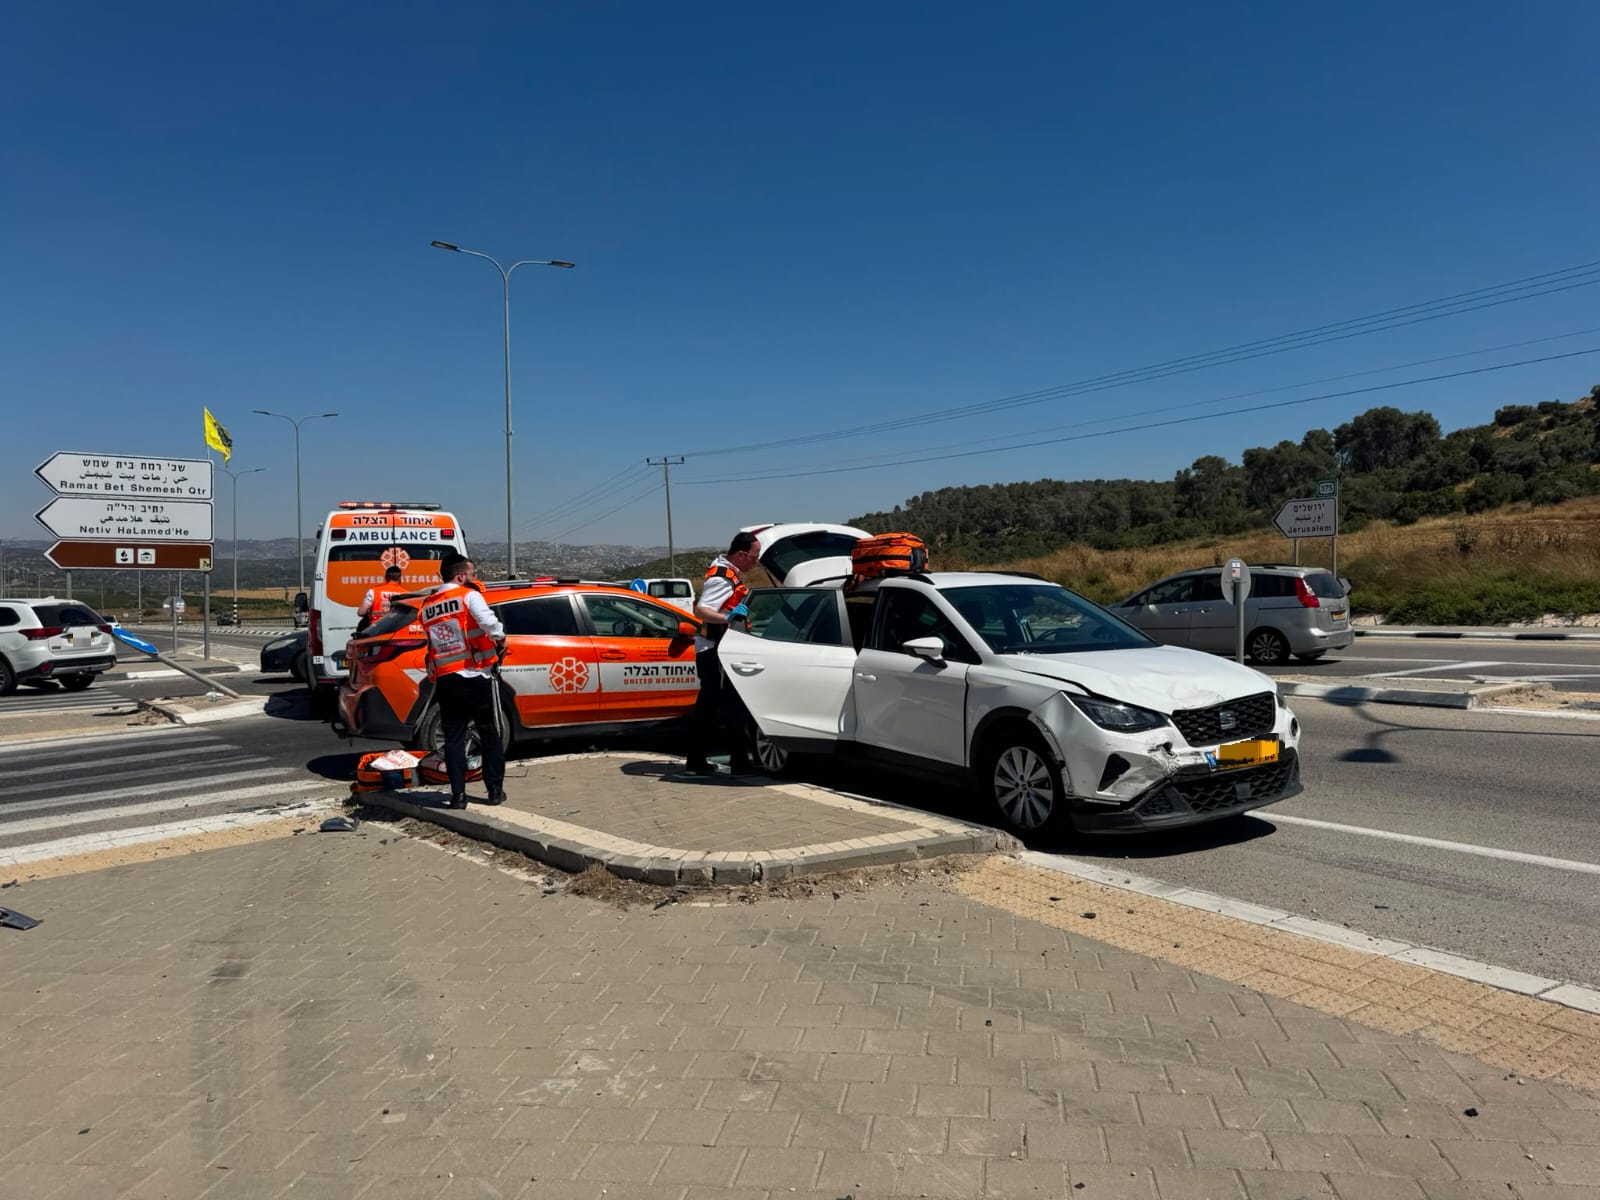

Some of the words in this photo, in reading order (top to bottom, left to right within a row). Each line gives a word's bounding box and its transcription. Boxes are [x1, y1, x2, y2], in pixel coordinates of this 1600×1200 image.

[83, 458, 109, 467] שמש
[116, 460, 134, 470] בית
[140, 461, 162, 471] רמת
[60, 480, 99, 490] Ramat
[104, 483, 124, 491] Bet
[130, 483, 183, 494] Shemesh
[188, 486, 206, 495] Qtr
[141, 504, 164, 513] נתיב
[1293, 503, 1325, 512] ירושלים
[353, 516, 387, 525] הצלה
[399, 516, 433, 526] איחוד
[79, 525, 111, 534] Netiv
[117, 526, 190, 536] HaLamed'He
[1288, 525, 1331, 533] Jerusalem
[349, 531, 437, 540] AMBULANCE
[342, 576, 383, 584] UNITED
[425, 599, 459, 619] חובש
[624, 665, 659, 676] הצלה
[662, 665, 695, 676] איחוד
